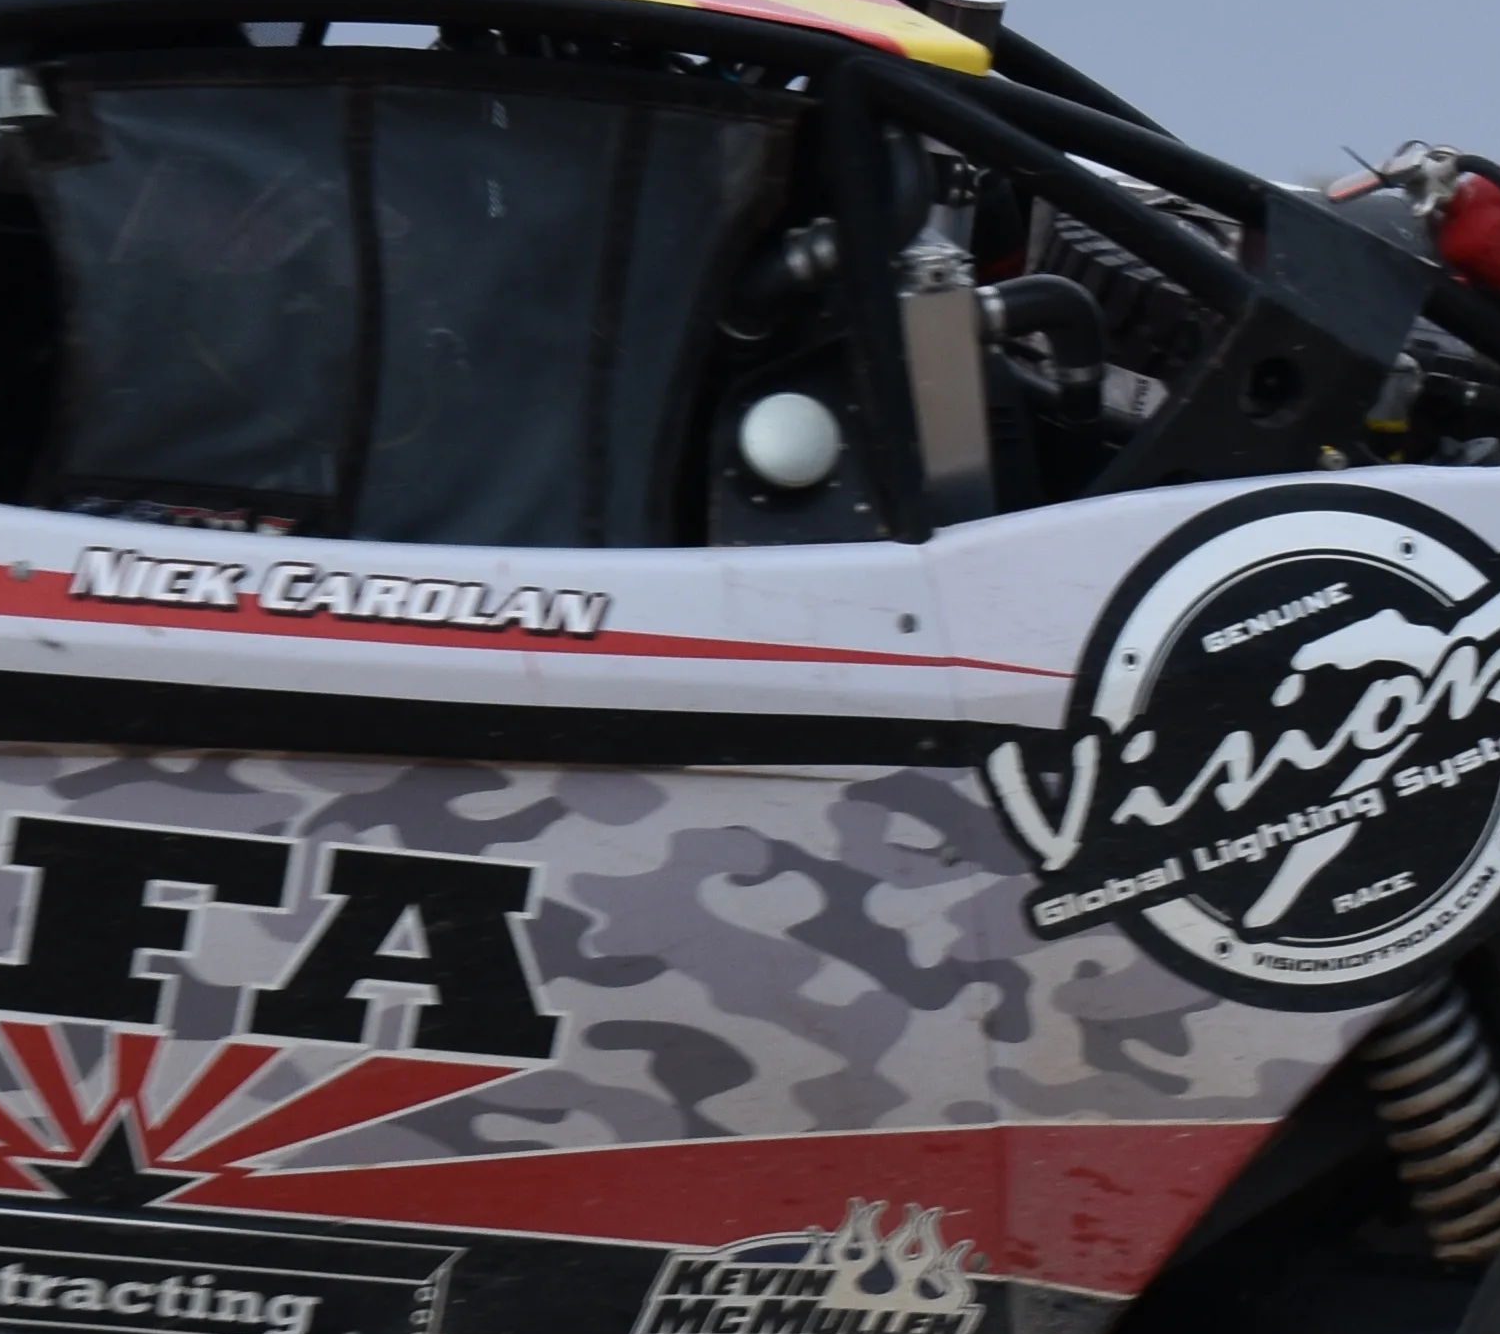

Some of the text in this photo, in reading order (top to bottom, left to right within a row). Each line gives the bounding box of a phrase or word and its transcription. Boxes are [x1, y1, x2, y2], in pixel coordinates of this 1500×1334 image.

[70, 547, 611, 640] NICK CAROLAN
[1202, 581, 1353, 653] GENUINE
[1033, 857, 1184, 927] Global
[1194, 777, 1387, 874] Lighting
[1331, 870, 1418, 915] RACE
[665, 1260, 838, 1296] KEVIN
